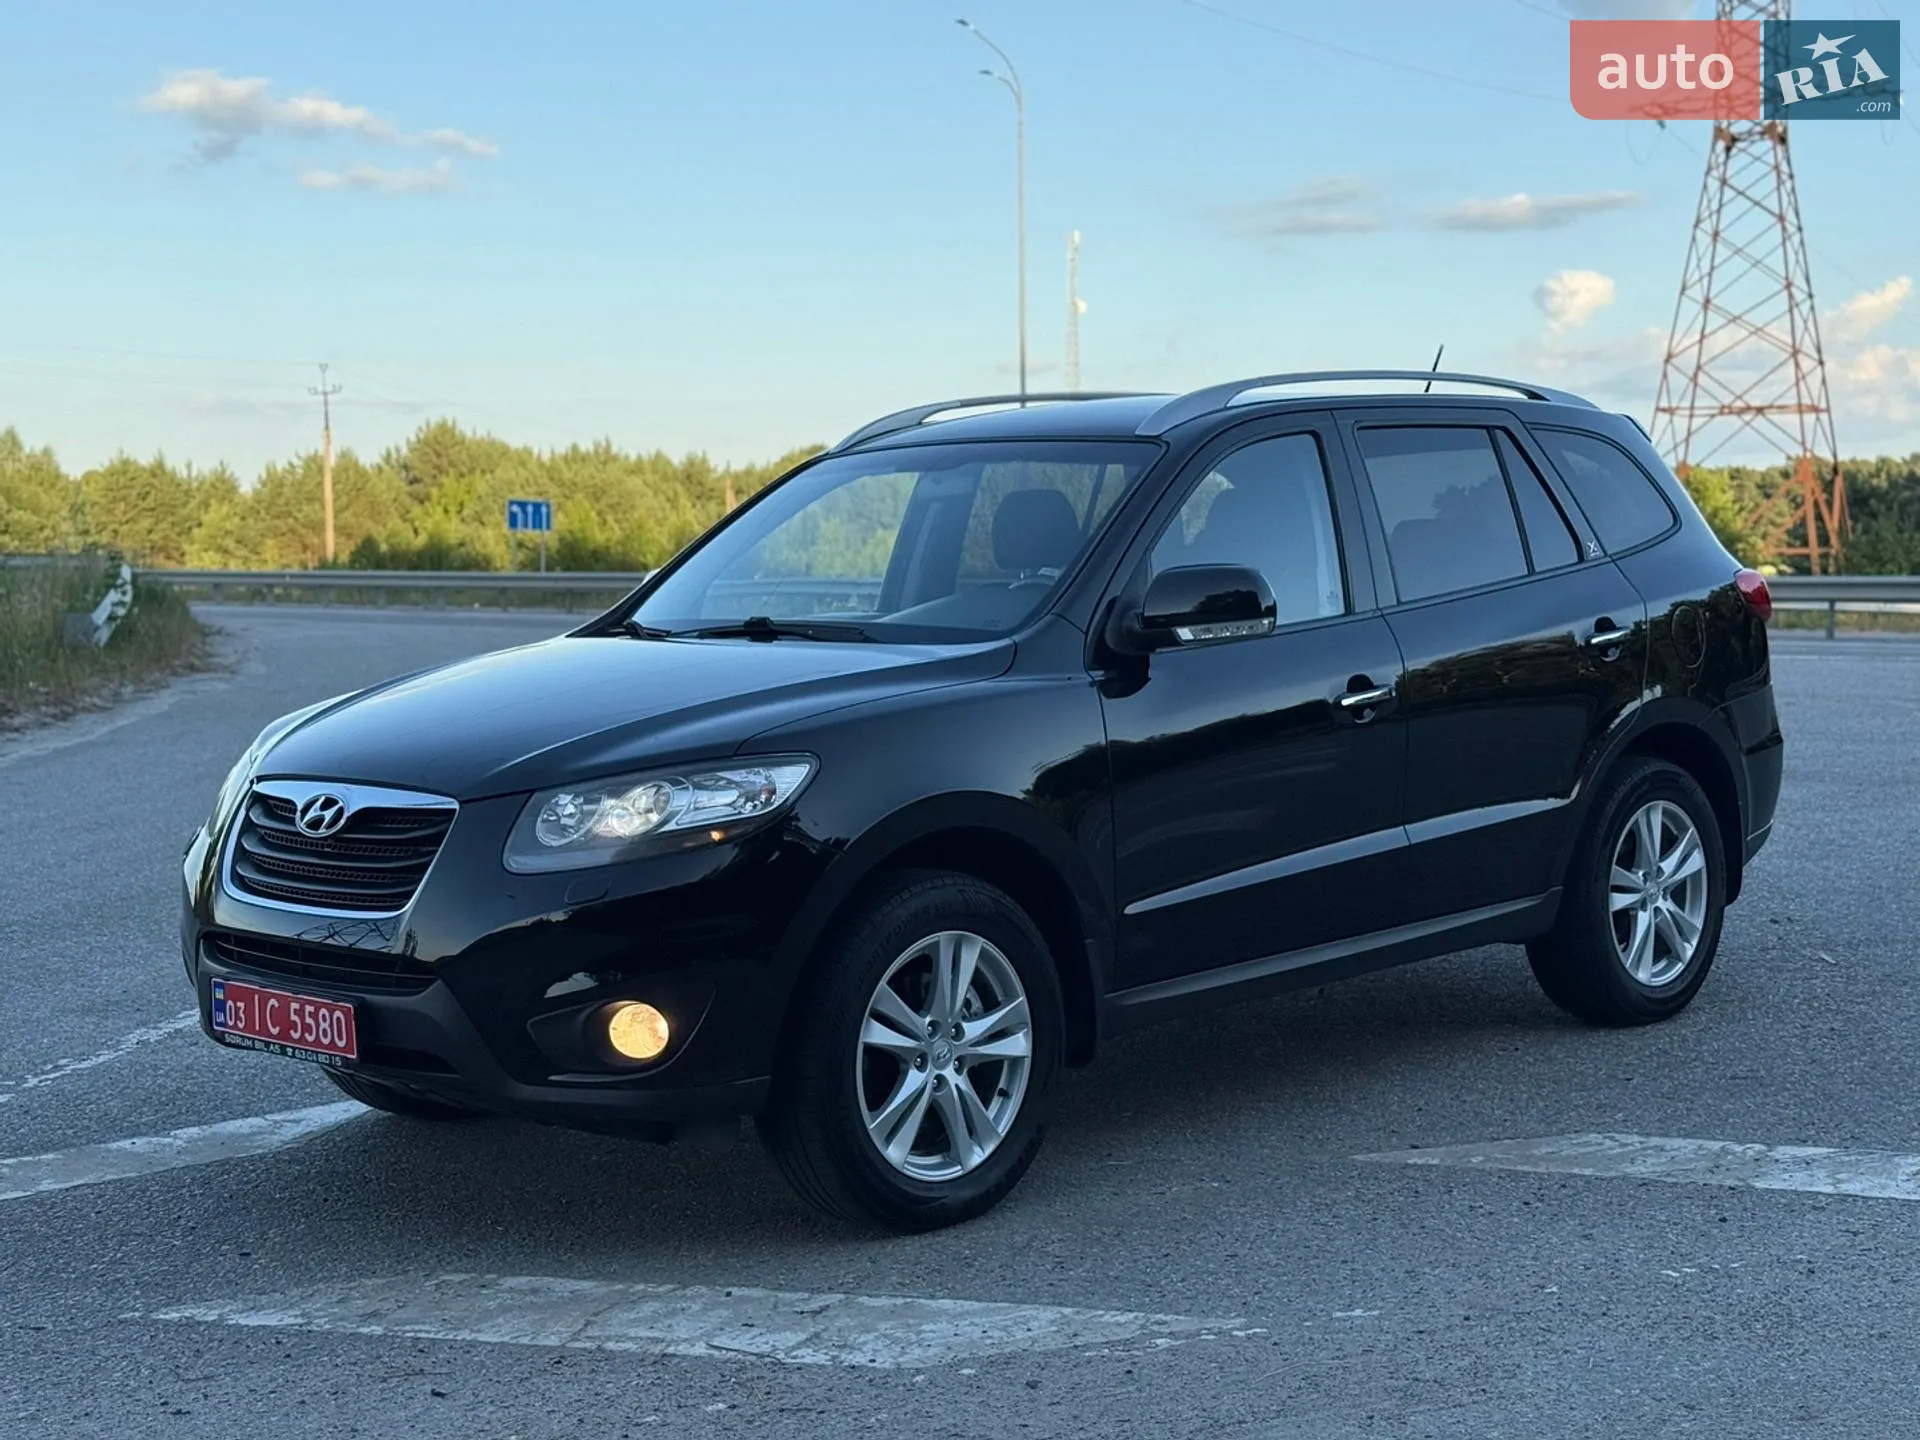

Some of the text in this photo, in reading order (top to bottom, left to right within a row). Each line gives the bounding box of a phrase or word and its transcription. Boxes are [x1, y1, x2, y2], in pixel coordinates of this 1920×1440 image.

[216, 1012, 225, 1023] UA
[226, 994, 347, 1048] 03 IC 5580
